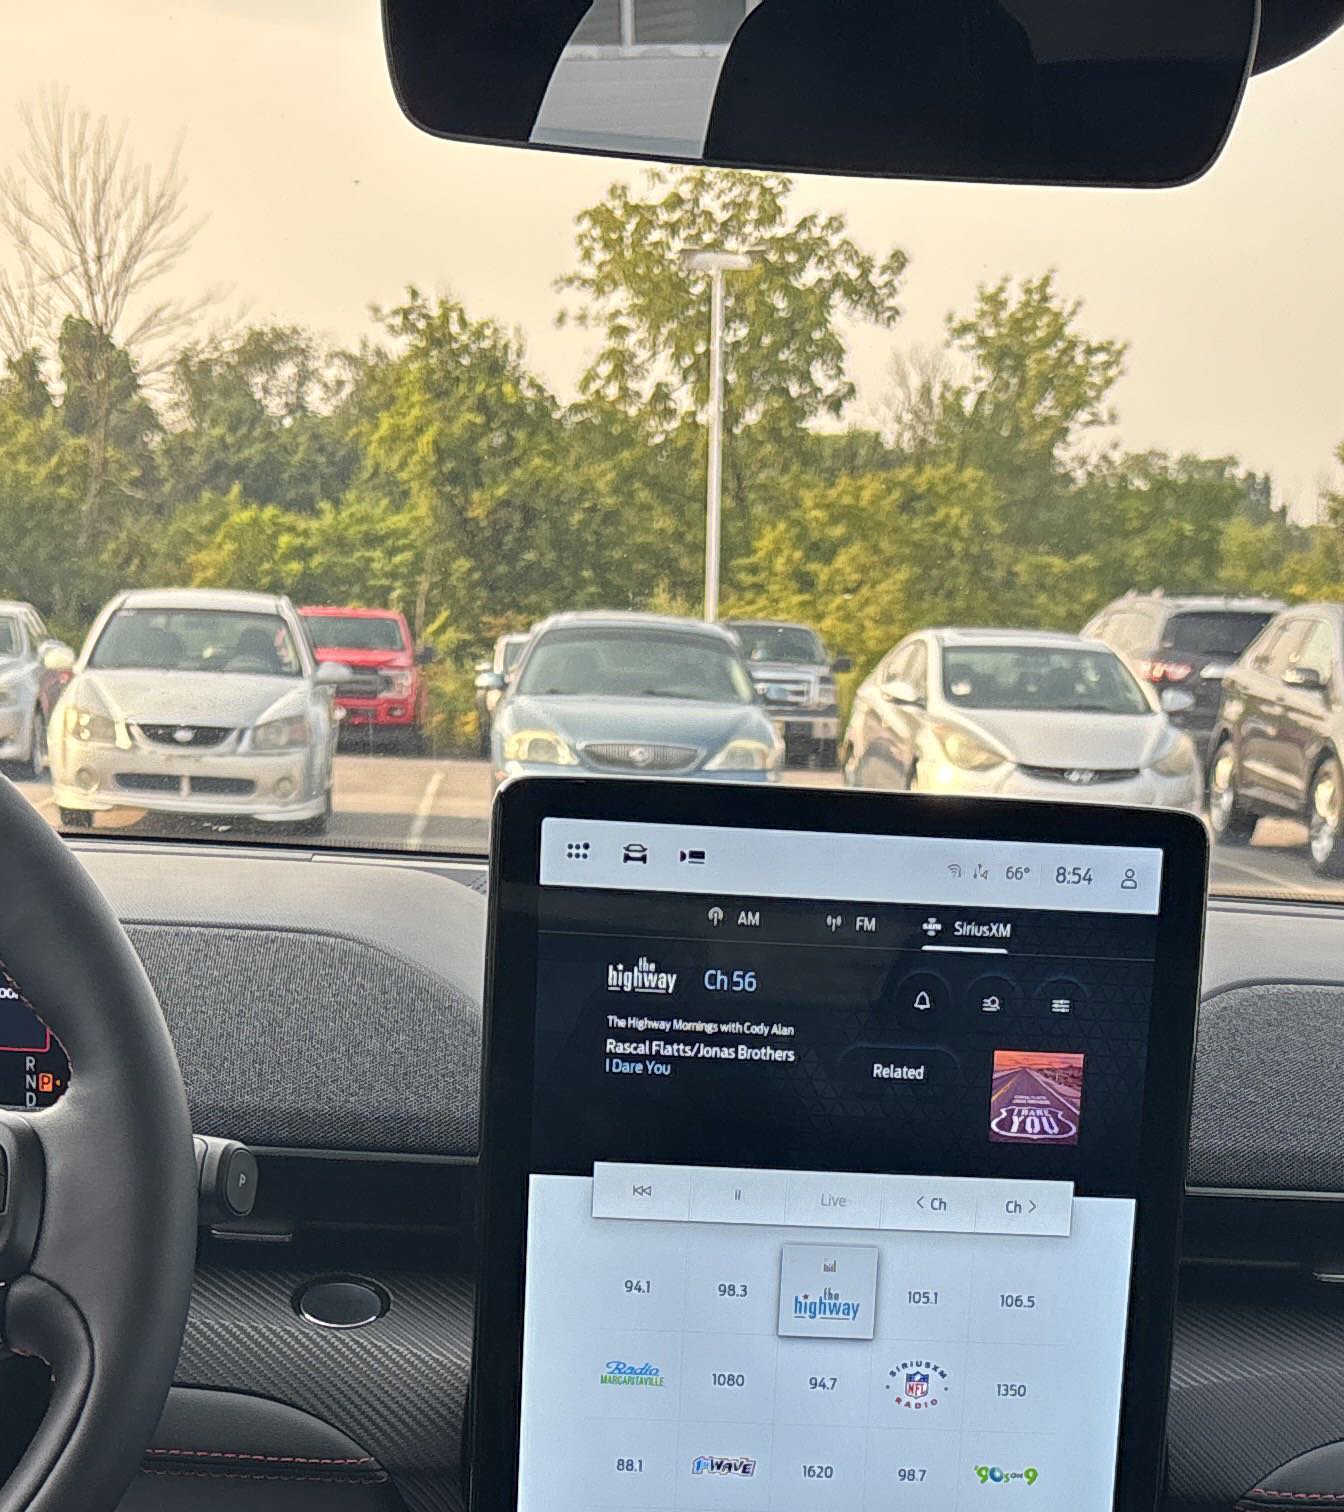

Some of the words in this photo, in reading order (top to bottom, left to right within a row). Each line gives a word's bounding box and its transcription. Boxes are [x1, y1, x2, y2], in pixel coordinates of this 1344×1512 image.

[1005, 866, 1031, 880] 66°
[1055, 866, 1094, 886] 8:54
[737, 911, 760, 926] AM
[855, 917, 876, 932] FM
[953, 921, 1011, 938] SiriusXM
[639, 957, 656, 972] the
[607, 964, 677, 994] highway
[704, 969, 727, 991] Ch
[732, 971, 757, 992] 56
[607, 1015, 626, 1028] The
[627, 1016, 671, 1032] Highway
[673, 1019, 719, 1034] Mornings
[720, 1020, 743, 1033] with
[743, 1022, 769, 1037] Cody
[771, 1023, 795, 1036] Alan
[606, 1038, 650, 1055] Rascal
[652, 1040, 735, 1058] Flatts/Jonas
[738, 1044, 795, 1062] Brothers
[26, 1056, 36, 1071] R
[612, 1059, 644, 1074] Dare
[645, 1060, 672, 1076] You
[872, 1063, 925, 1080] Related
[26, 1074, 36, 1089] N
[41, 1075, 51, 1089] P
[26, 1091, 37, 1107] D
[1010, 1115, 1060, 1135] YOU
[239, 1173, 246, 1187] P
[820, 1193, 847, 1207] Live
[930, 1198, 947, 1211] Ch
[1005, 1200, 1022, 1214] Ch
[624, 1279, 651, 1294] 94.1
[717, 1283, 748, 1298] 98.3
[823, 1287, 840, 1301] the
[907, 1291, 938, 1305] 105.1
[1000, 1294, 1035, 1309] 106.5
[794, 1295, 860, 1320] highway
[606, 1360, 660, 1376] Radio
[889, 1360, 948, 1379] SIRIUSXM
[600, 1374, 665, 1387] MARGARITAVILLE
[712, 1372, 745, 1387] 1080
[808, 1376, 837, 1391] 94.7
[908, 1382, 927, 1395] NFL
[996, 1383, 1027, 1398] 1350
[895, 1395, 938, 1410] RADIO
[616, 1458, 643, 1473] 88.1
[802, 1465, 833, 1479] 1620
[897, 1468, 927, 1482] 98.7
[1023, 1467, 1039, 1486] 9
